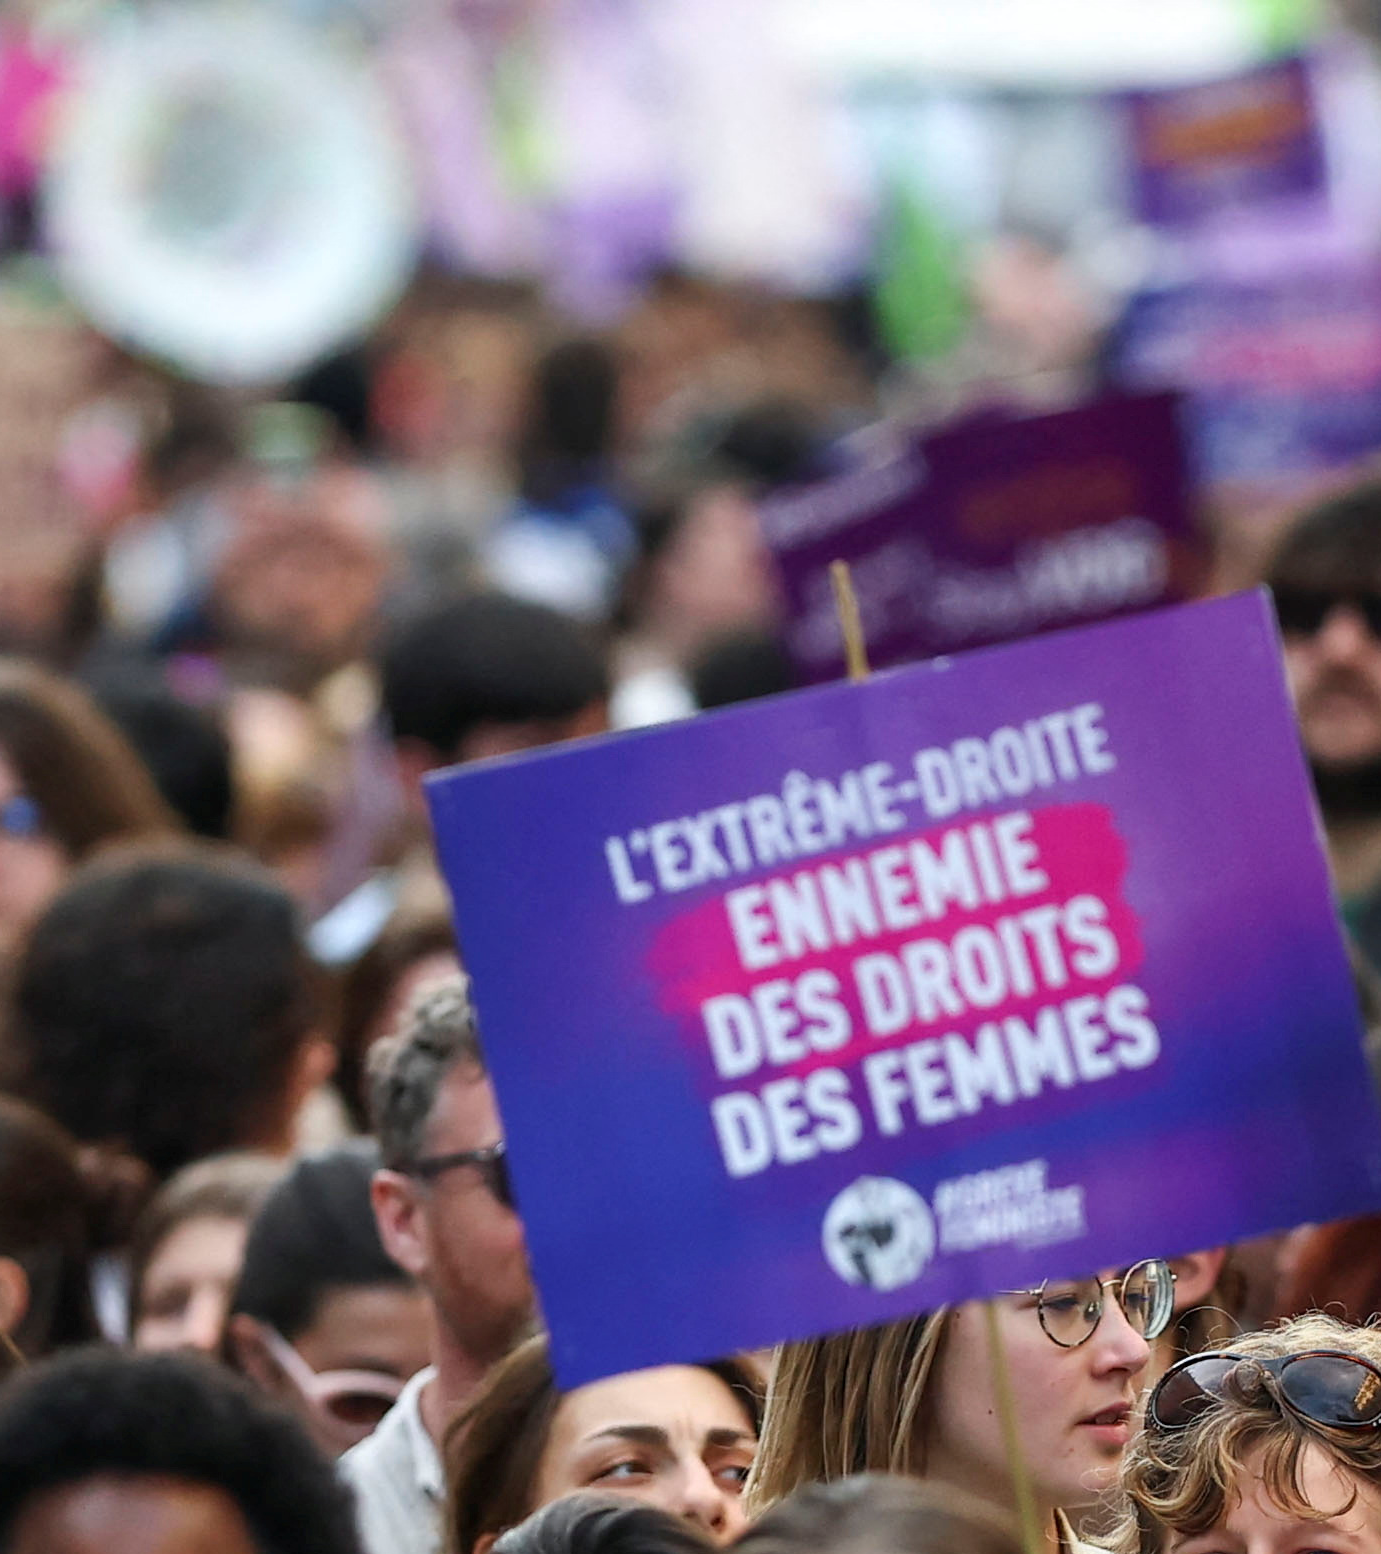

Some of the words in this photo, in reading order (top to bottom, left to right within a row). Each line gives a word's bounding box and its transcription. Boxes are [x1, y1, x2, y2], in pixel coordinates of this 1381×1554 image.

[604, 701, 1115, 904] L'EXTRÊME-DROITE
[724, 810, 1049, 971] ENNEMIE
[702, 968, 853, 1080] DES
[852, 893, 1119, 1037] DROITS
[712, 1066, 863, 1179] DES
[863, 984, 1160, 1137] FEMMES
